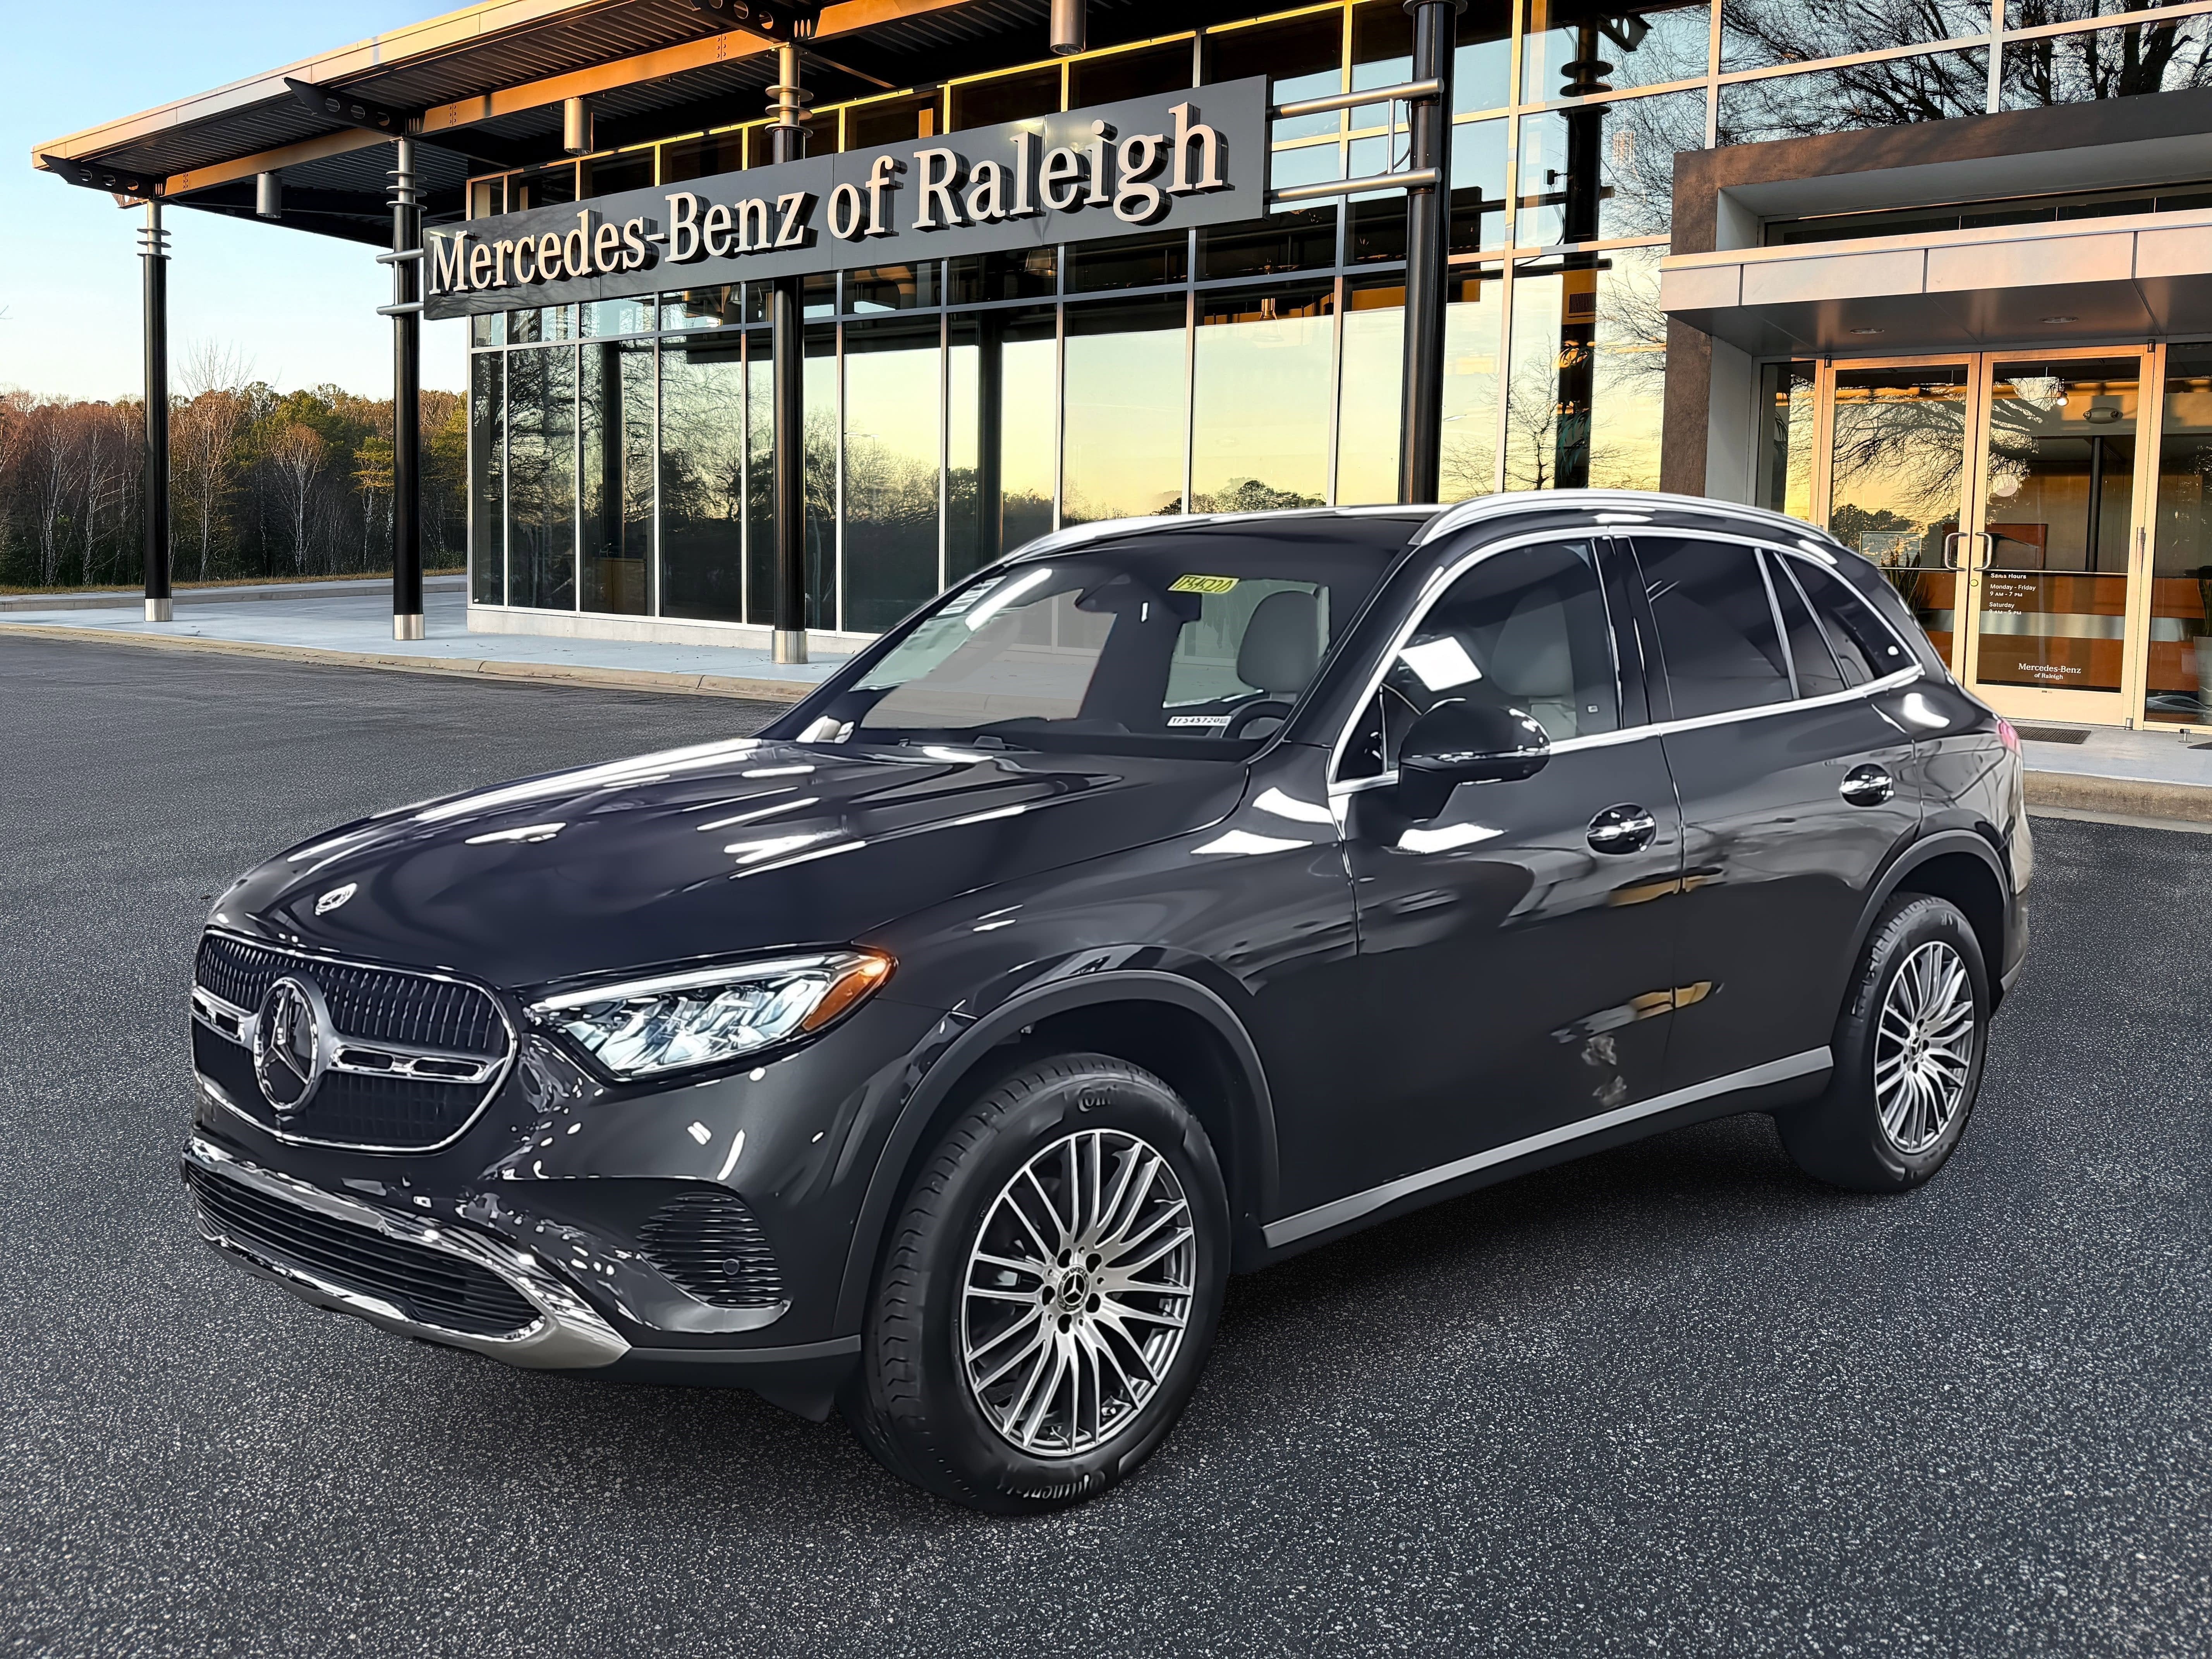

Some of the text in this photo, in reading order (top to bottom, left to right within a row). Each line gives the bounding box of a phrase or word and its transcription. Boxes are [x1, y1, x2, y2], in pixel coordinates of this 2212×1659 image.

[429, 101, 1224, 295] Mercedes-Benz of Raleigh
[2018, 663, 2081, 674] Mercedes-Benz
